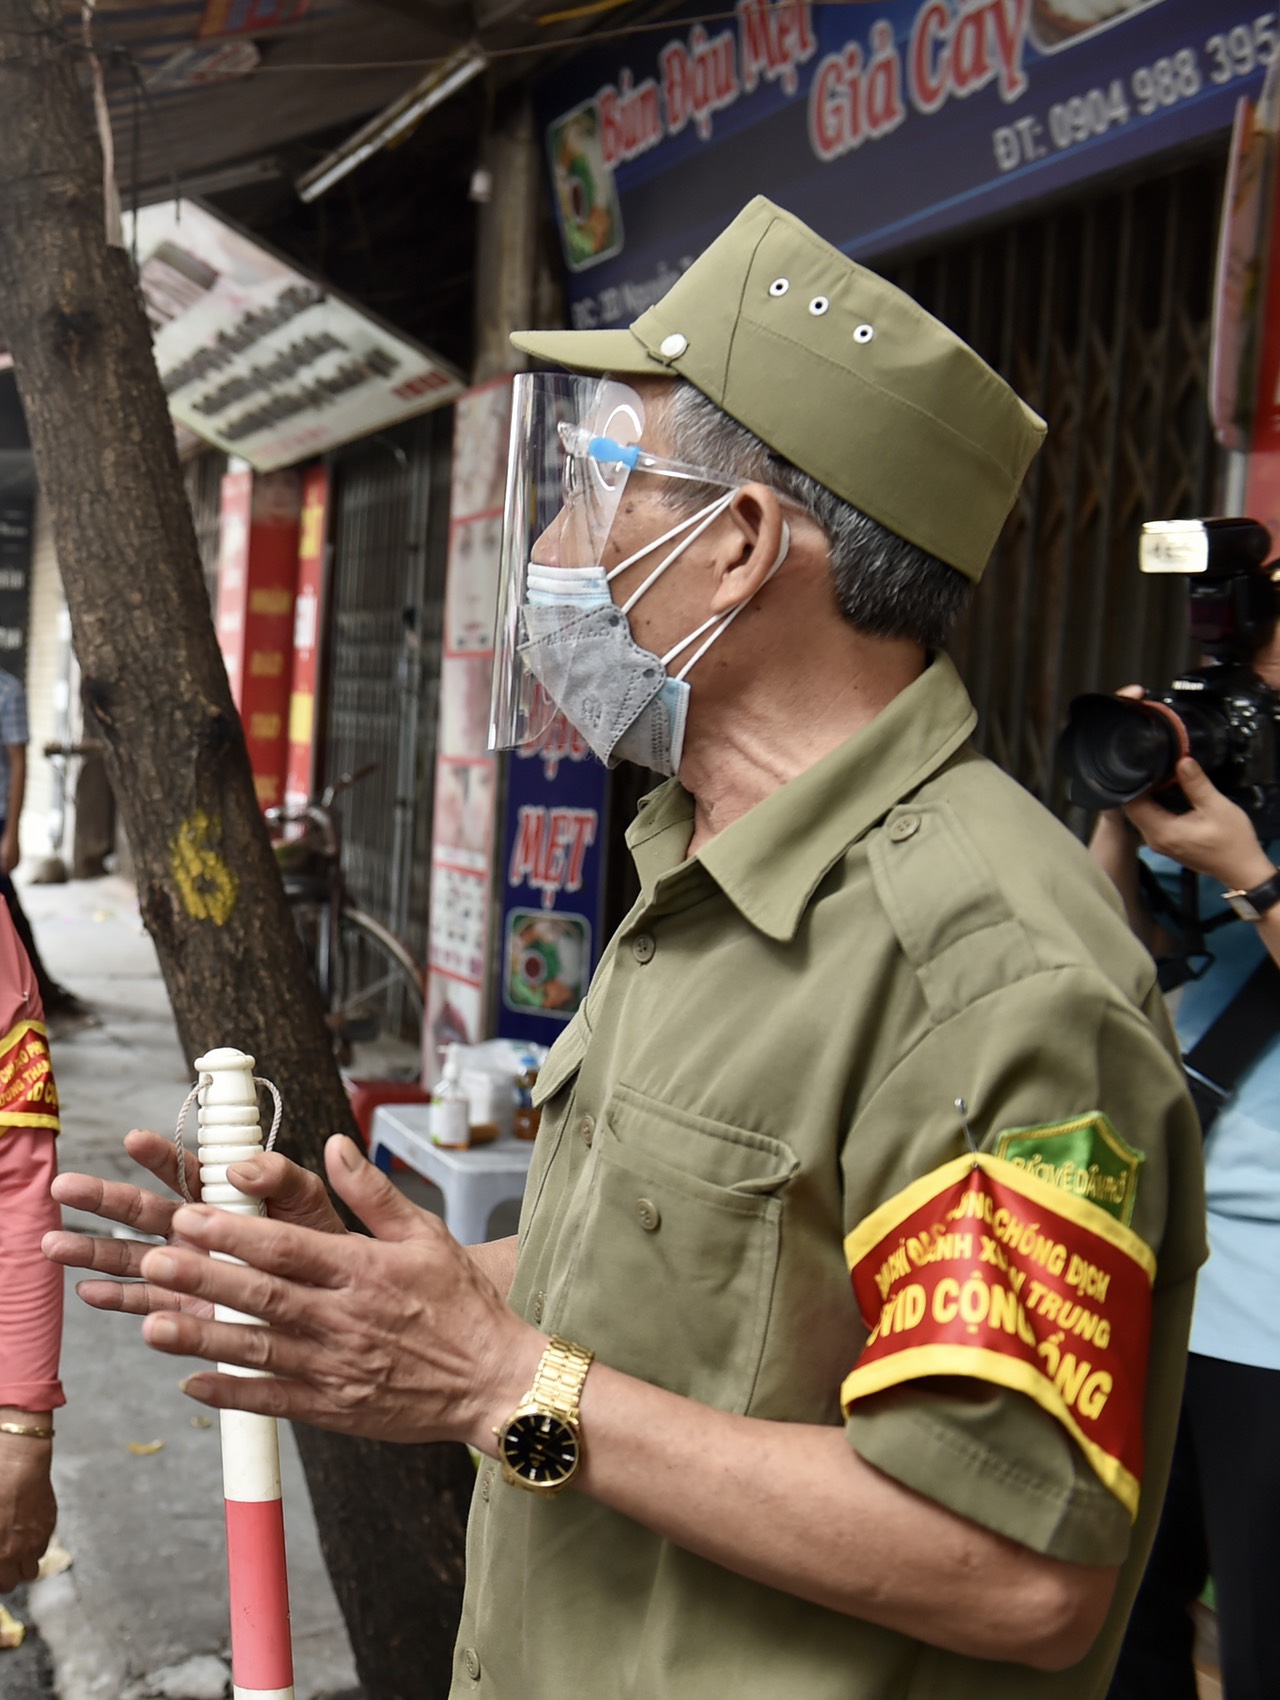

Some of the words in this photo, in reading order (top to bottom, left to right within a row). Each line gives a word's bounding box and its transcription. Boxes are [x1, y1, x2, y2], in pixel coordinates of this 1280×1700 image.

[808, 18, 907, 162] Giả
[1048, 79, 1129, 149] 0904
[1132, 47, 1202, 116] 988
[1205, 12, 1278, 84] 395
[1172, 680, 1204, 690] Nikon
[992, 1207, 1068, 1277] CHỐNG
[1064, 1252, 1111, 1304] DỊCH
[1026, 1279, 1112, 1350] TRUNG
